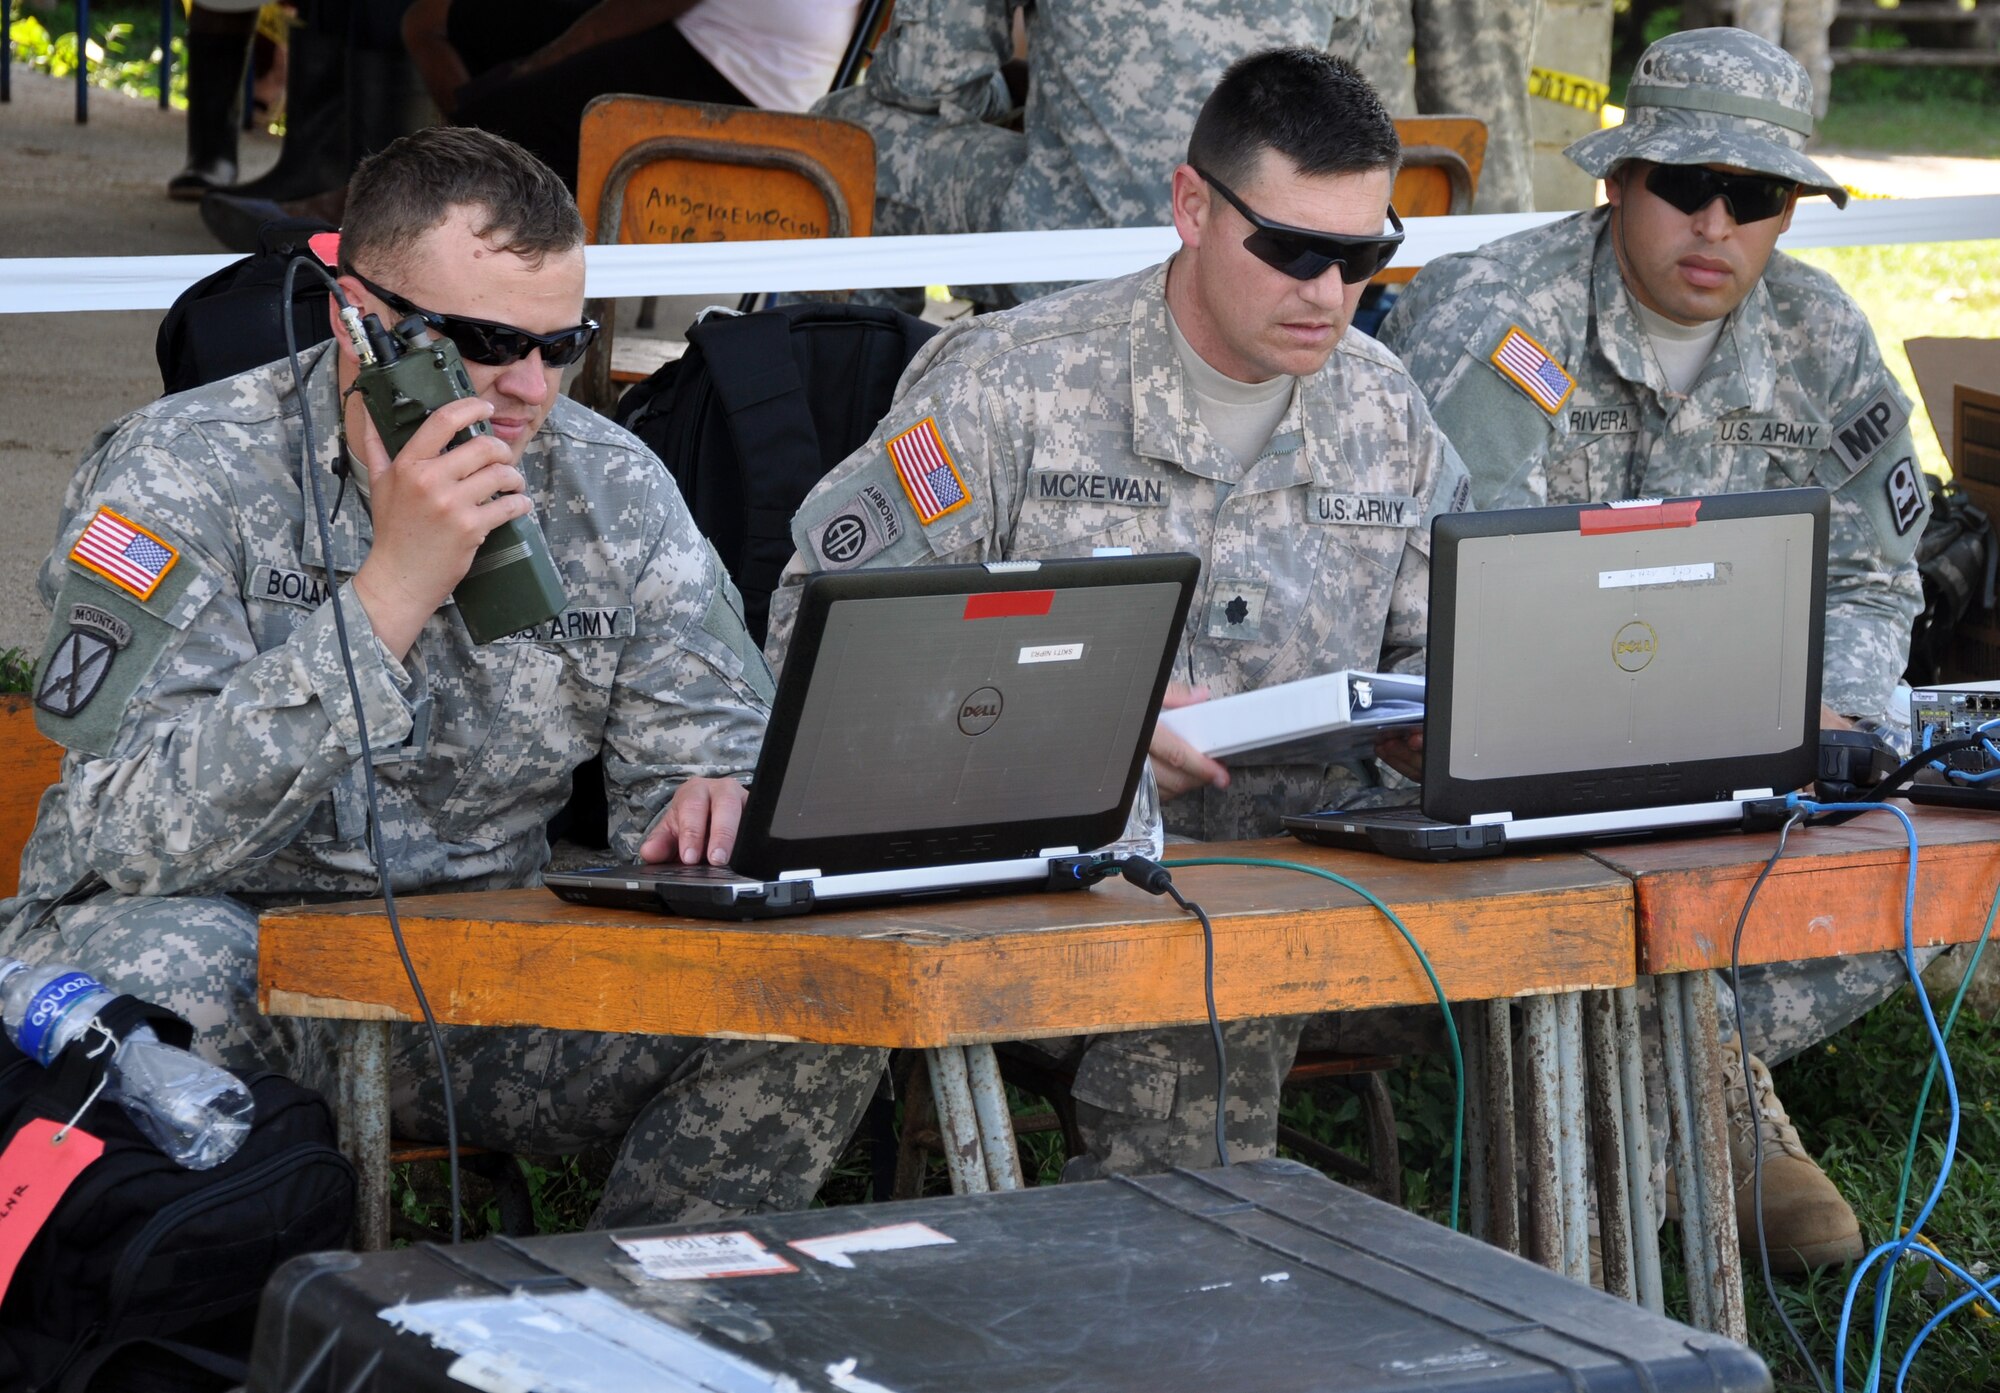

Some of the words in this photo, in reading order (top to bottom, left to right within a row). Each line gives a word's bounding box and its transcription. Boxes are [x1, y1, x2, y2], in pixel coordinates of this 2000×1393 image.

[1570, 410, 1629, 431] RIVERA
[1721, 422, 1753, 442] U.S.
[1760, 422, 1820, 446] ARMY
[1838, 401, 1892, 462] MP
[1040, 473, 1162, 502] MCKEWAN
[863, 486, 898, 541] AIRBORNE
[1318, 498, 1350, 521] U.S.
[1356, 500, 1405, 524] ARMY
[74, 608, 126, 641] MOUNTAIN
[550, 611, 619, 639] ARMY
[1617, 639, 1652, 654] DELL
[962, 704, 998, 718] DELL
